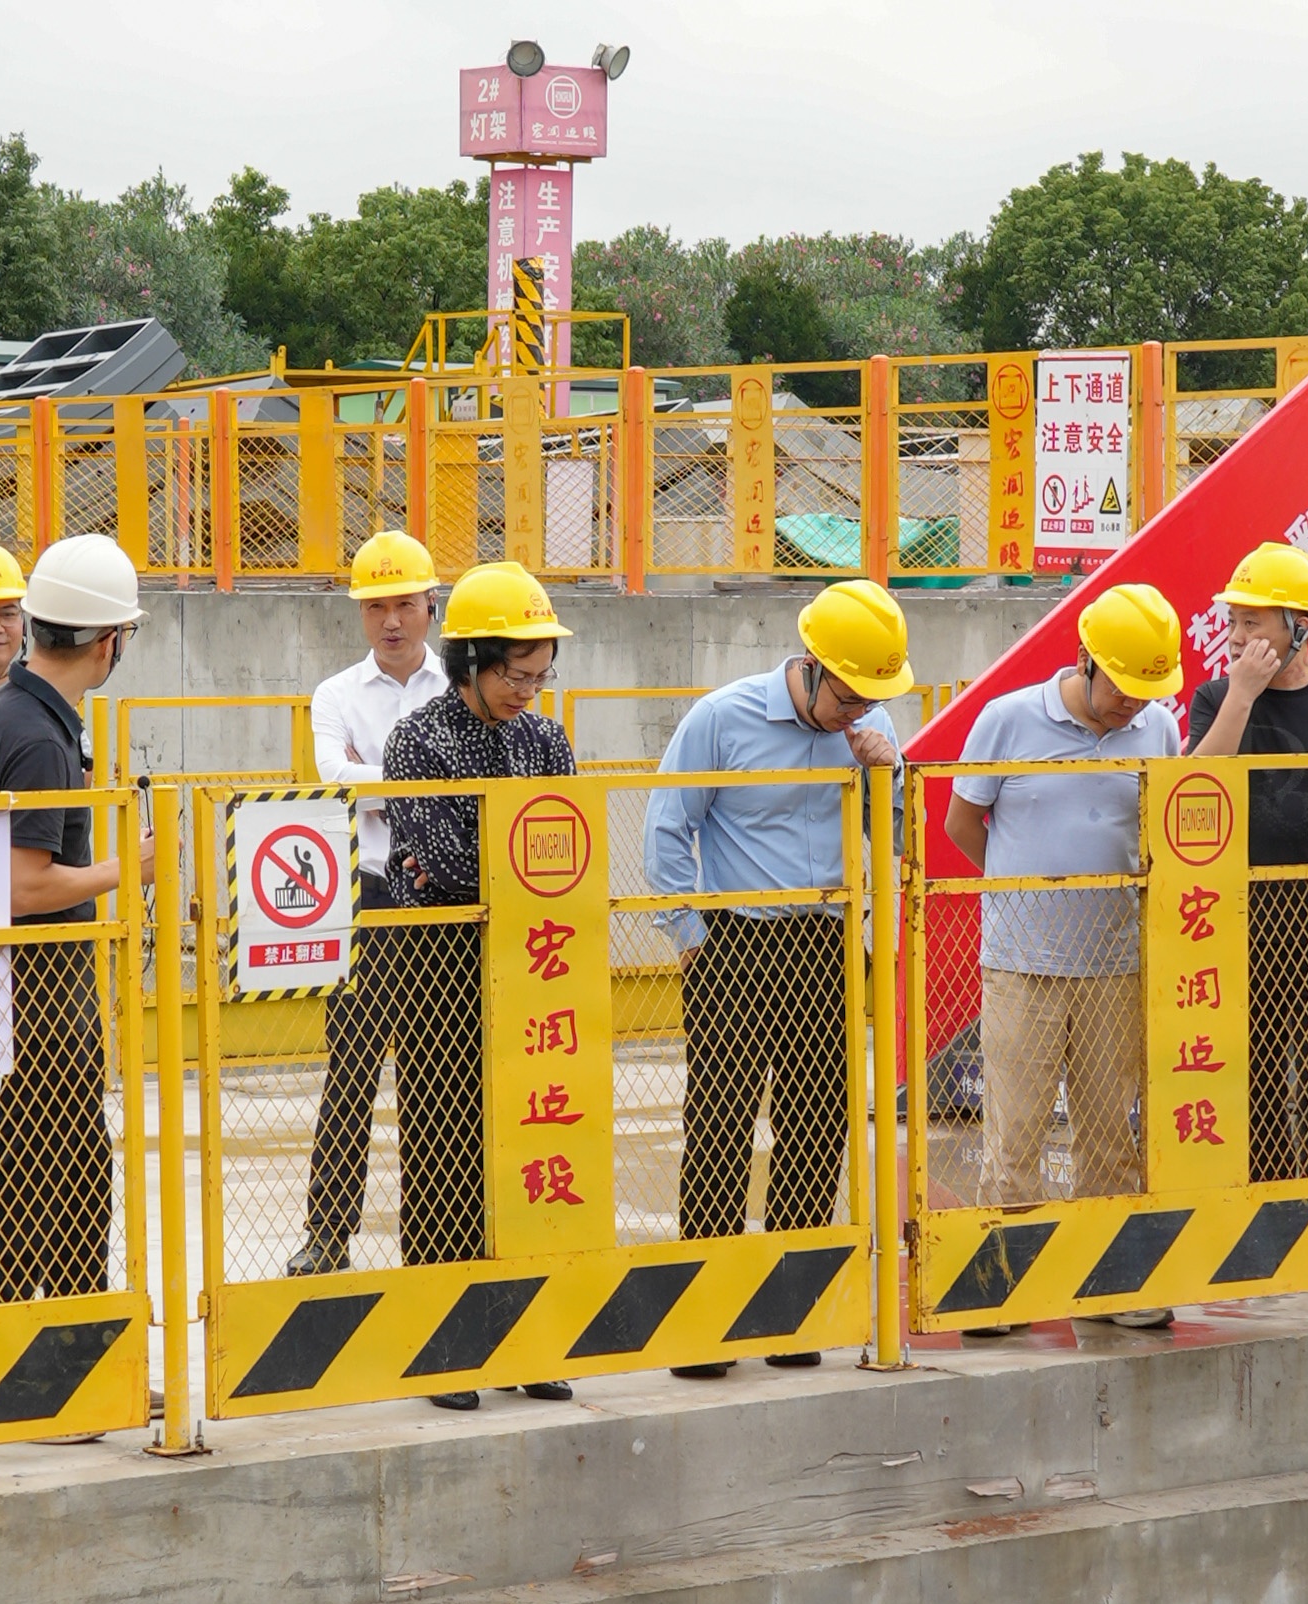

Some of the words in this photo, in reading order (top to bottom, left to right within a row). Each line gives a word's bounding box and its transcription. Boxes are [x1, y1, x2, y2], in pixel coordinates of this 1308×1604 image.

[477, 77, 500, 103] 2#
[470, 110, 507, 142] 灯架
[1042, 372, 1124, 404] 上下通道
[1042, 422, 1124, 454] 注意安全
[1180, 807, 1217, 832] HONGRUN
[529, 832, 571, 861] HONGRUN
[264, 942, 325, 964] 禁止翻越
[1173, 885, 1225, 1144] 宏润建设
[520, 918, 584, 1205] 宏润建设
